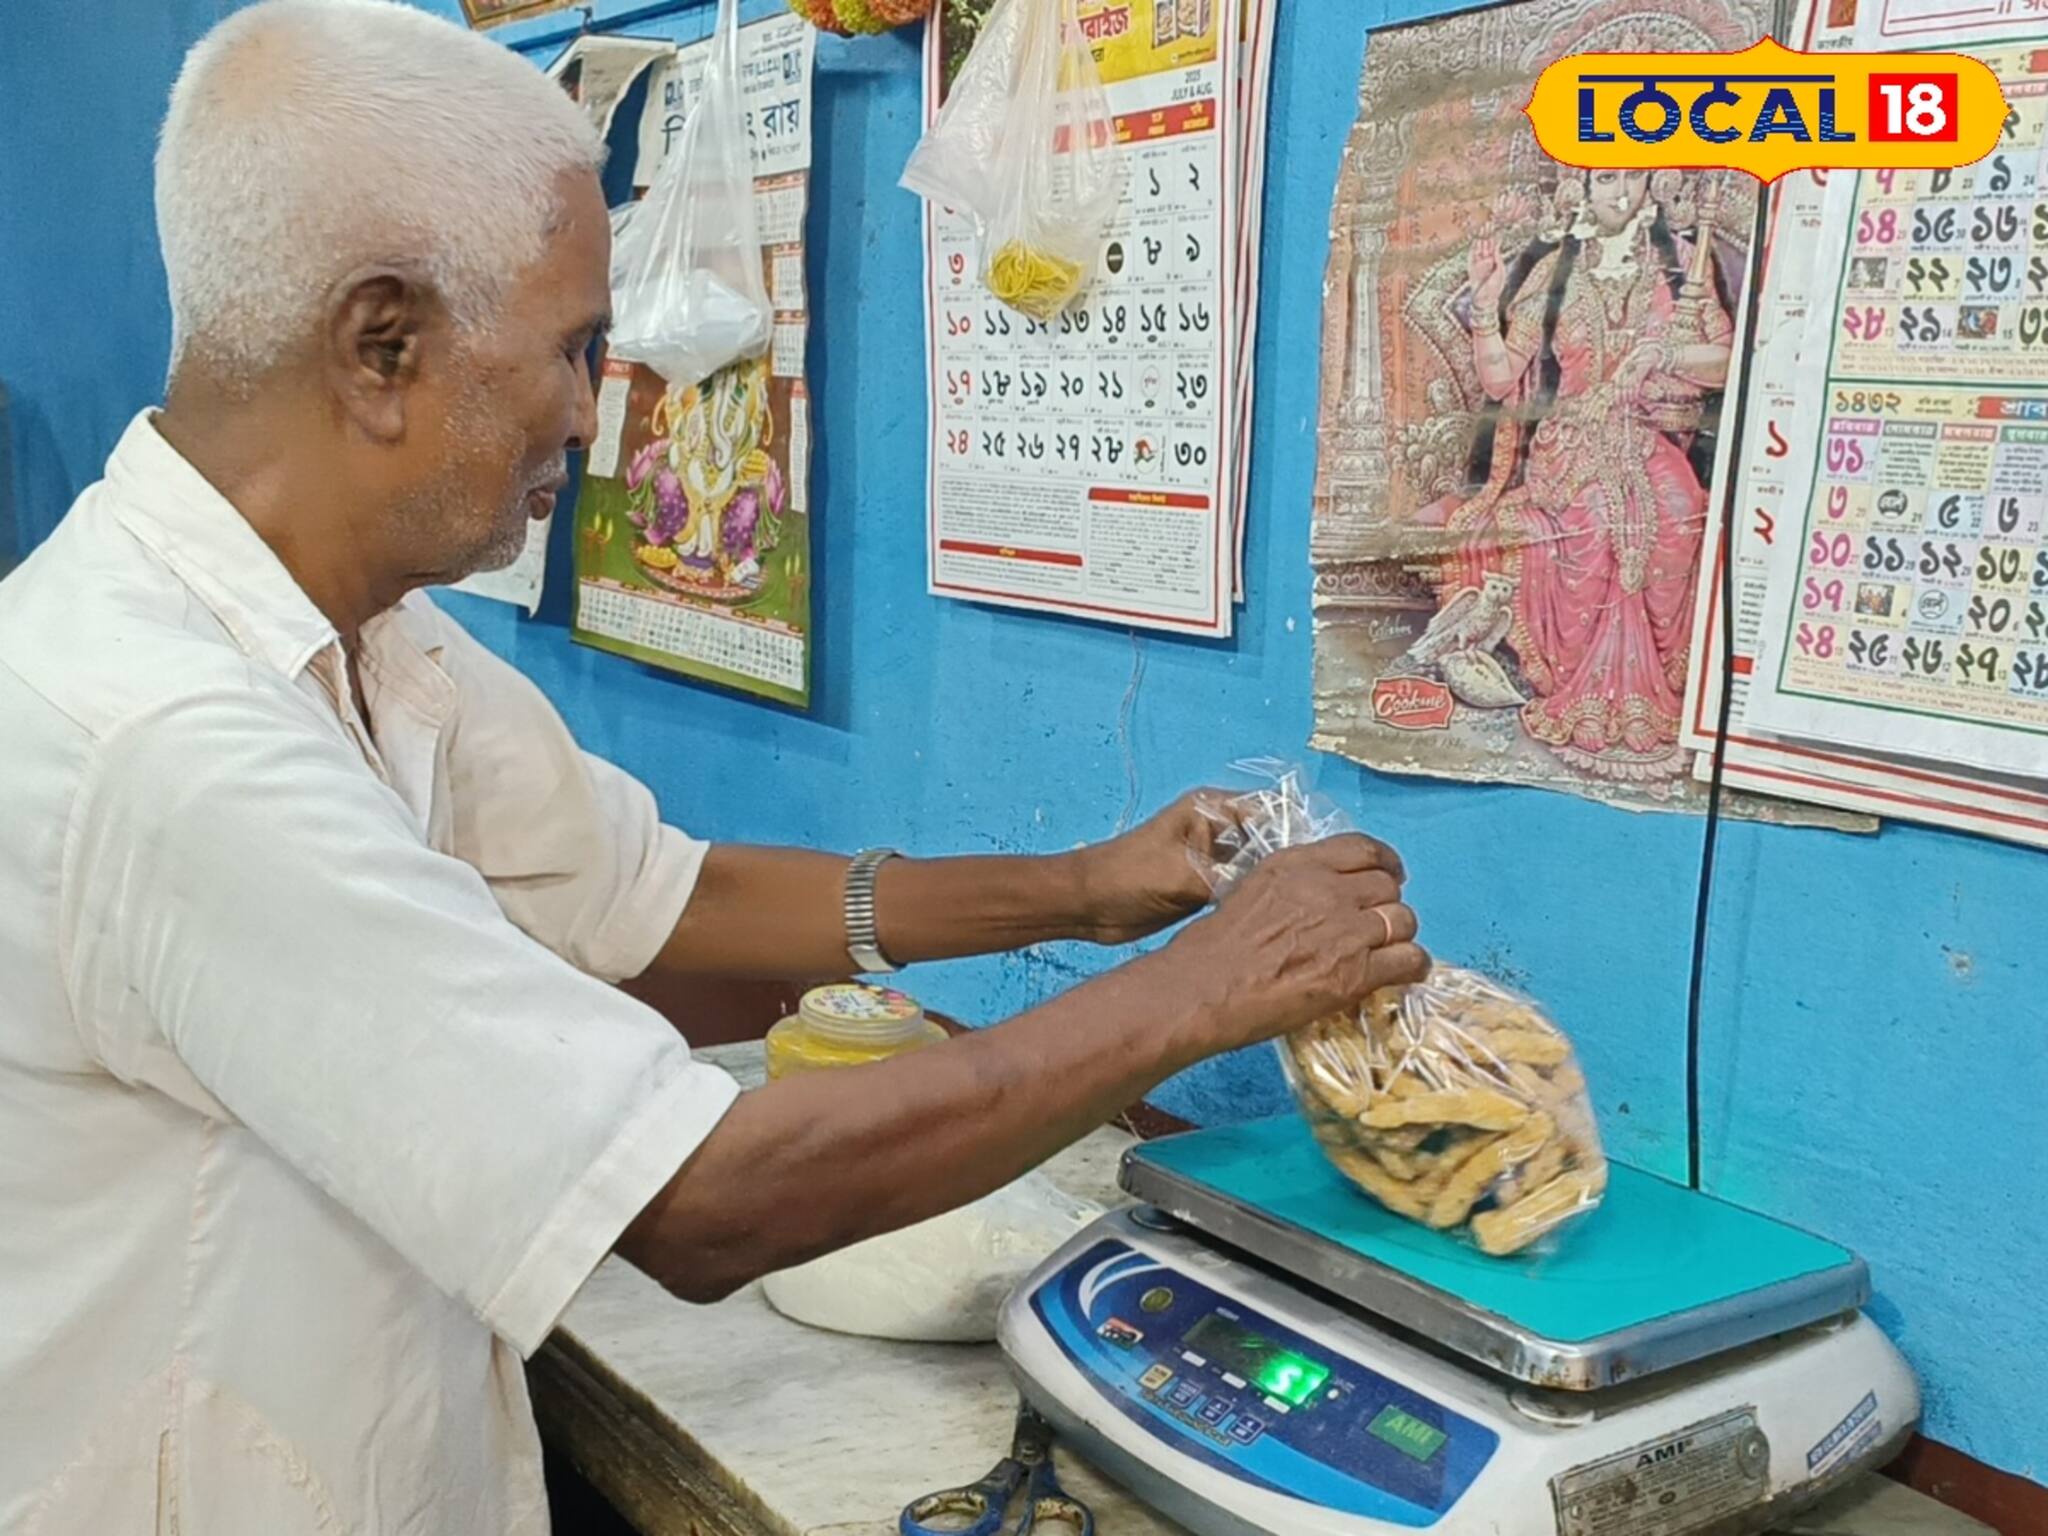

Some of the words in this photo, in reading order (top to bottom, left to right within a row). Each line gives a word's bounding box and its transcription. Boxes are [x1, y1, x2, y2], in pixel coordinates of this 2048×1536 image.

[760, 99, 801, 138] রায়
[1188, 163, 1200, 191] ২
[1990, 155, 2011, 192] ৯
[1857, 209, 1896, 244] ১৪
[1912, 208, 1956, 243] ১৫
[1971, 205, 2018, 242] ১৬
[948, 253, 964, 274] ৩
[1143, 236, 1162, 265] ৮
[1906, 257, 1950, 293] ২২
[1966, 256, 2011, 293] ২৩
[947, 310, 971, 336] ১০
[985, 309, 1010, 335] ১১
[1060, 309, 1089, 334] ১৩
[1102, 306, 1127, 334] ১৪
[1141, 303, 1167, 333] ১৫
[1179, 301, 1210, 334] ১৬
[1843, 306, 1886, 341] ২৮
[1900, 306, 1941, 342] ২৯
[2019, 307, 2048, 344] ৩
[947, 370, 970, 396] ১৭
[982, 370, 1010, 396] ১৮
[1021, 371, 1047, 397] ১৯
[1060, 371, 1084, 397] ২০
[1099, 371, 1124, 399] ২১
[1176, 371, 1208, 398] ২৩
[1835, 391, 1901, 415] ১৪৩২
[947, 429, 969, 454] ২৪
[982, 431, 1005, 457] ২৫
[1017, 432, 1044, 459] ২৬
[1056, 434, 1079, 461] ২৭
[1092, 436, 1124, 464] ২৮
[1175, 442, 1207, 466] ৩০
[1766, 420, 1788, 458] ১
[1827, 438, 1864, 473] ৩১
[1754, 507, 1774, 545] ২
[1827, 486, 1848, 519] ৩
[1938, 494, 1961, 529] ৫
[1998, 497, 2020, 534] ৬
[1809, 531, 1851, 567] ১০
[1863, 536, 1905, 572] ১১
[1919, 541, 1962, 578] ১২
[1976, 546, 2021, 583] ১৩
[1802, 576, 1844, 612] ১৭
[1968, 594, 2011, 633] ২০
[1796, 622, 1836, 658] ২৪
[1849, 630, 1889, 667] ২৫
[1903, 636, 1943, 674] ২৬
[1956, 643, 1999, 682] ২৭
[1384, 1414, 1433, 1443] AMI
